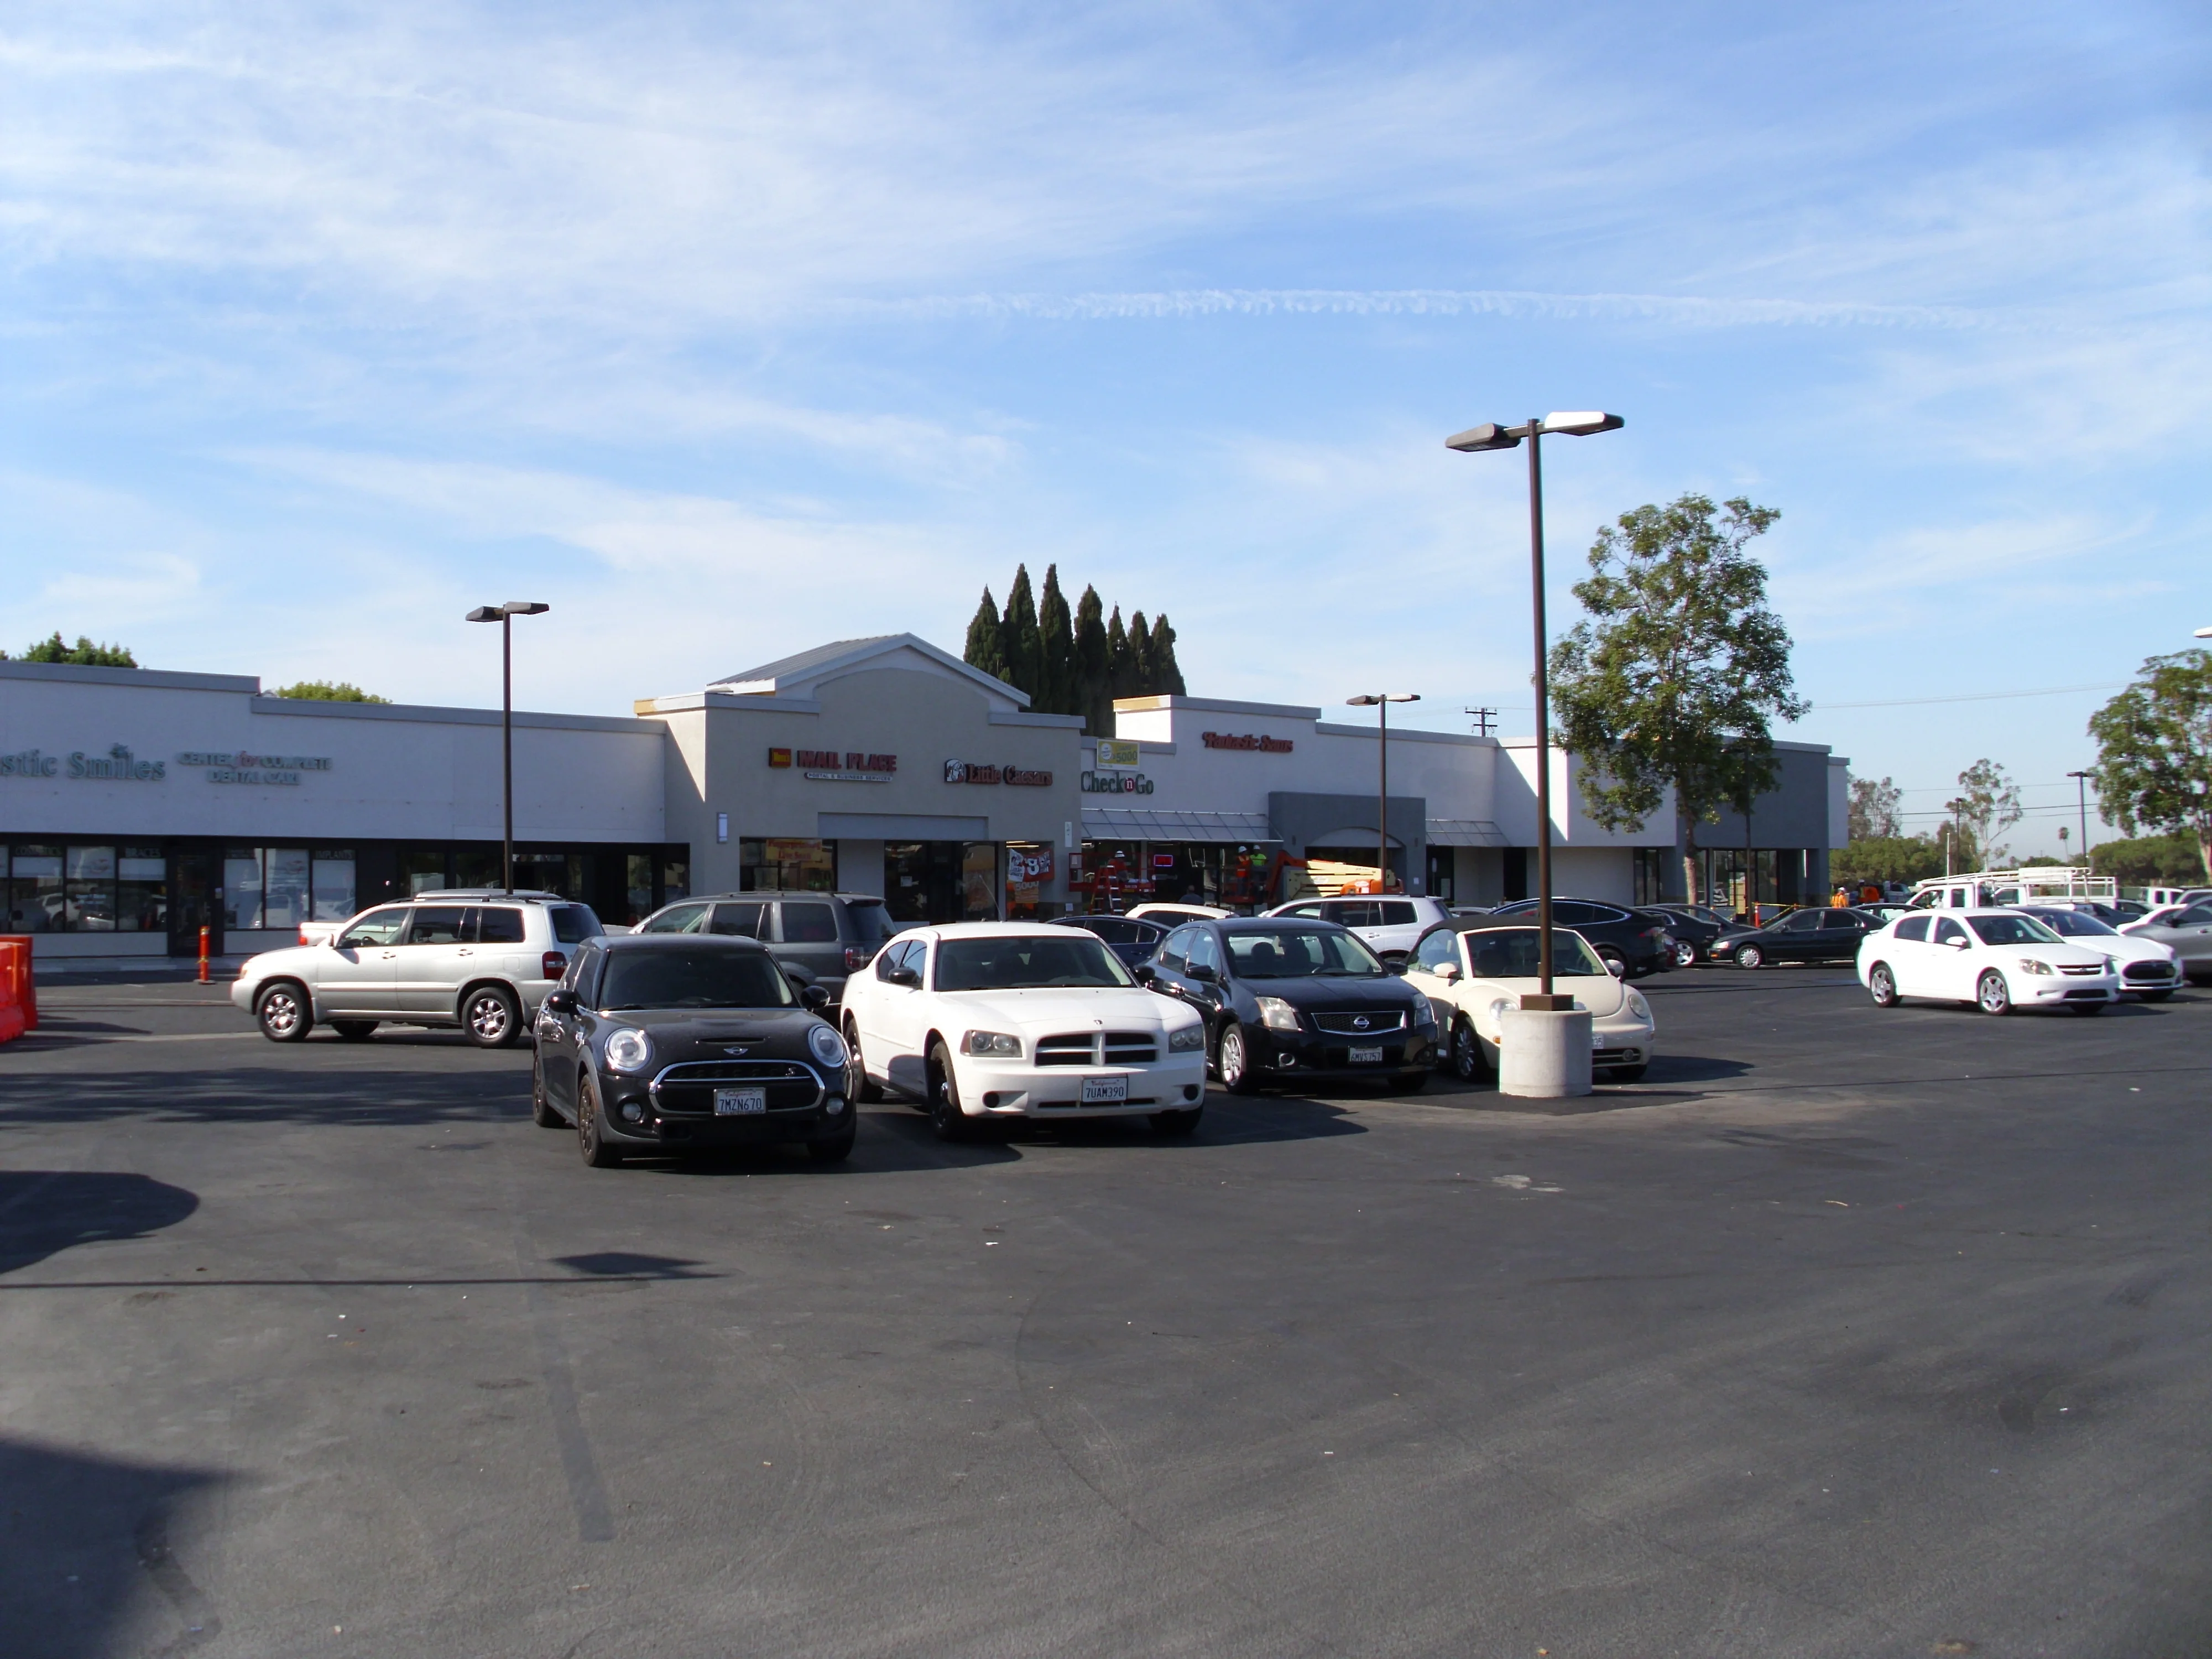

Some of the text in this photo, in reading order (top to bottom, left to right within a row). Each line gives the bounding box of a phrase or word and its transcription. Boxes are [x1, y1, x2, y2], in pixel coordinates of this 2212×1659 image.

[1202, 732, 1293, 752] Fantastic Sams
[67, 749, 166, 779] Smiles
[177, 752, 234, 766] CENTER
[260, 755, 333, 769] COMPLETE
[797, 750, 842, 769] MAIL
[846, 753, 896, 771] PLACE
[206, 769, 302, 785] DENTAL CARE
[965, 764, 1052, 785] Little Caesars
[1081, 771, 1124, 792] Check
[1135, 774, 1154, 794] Go
[125, 848, 161, 858] BRACES
[316, 850, 353, 859] IMPLANTS
[1086, 1087, 1124, 1098] 7UAM390
[719, 1098, 762, 1111] 7MZN670
